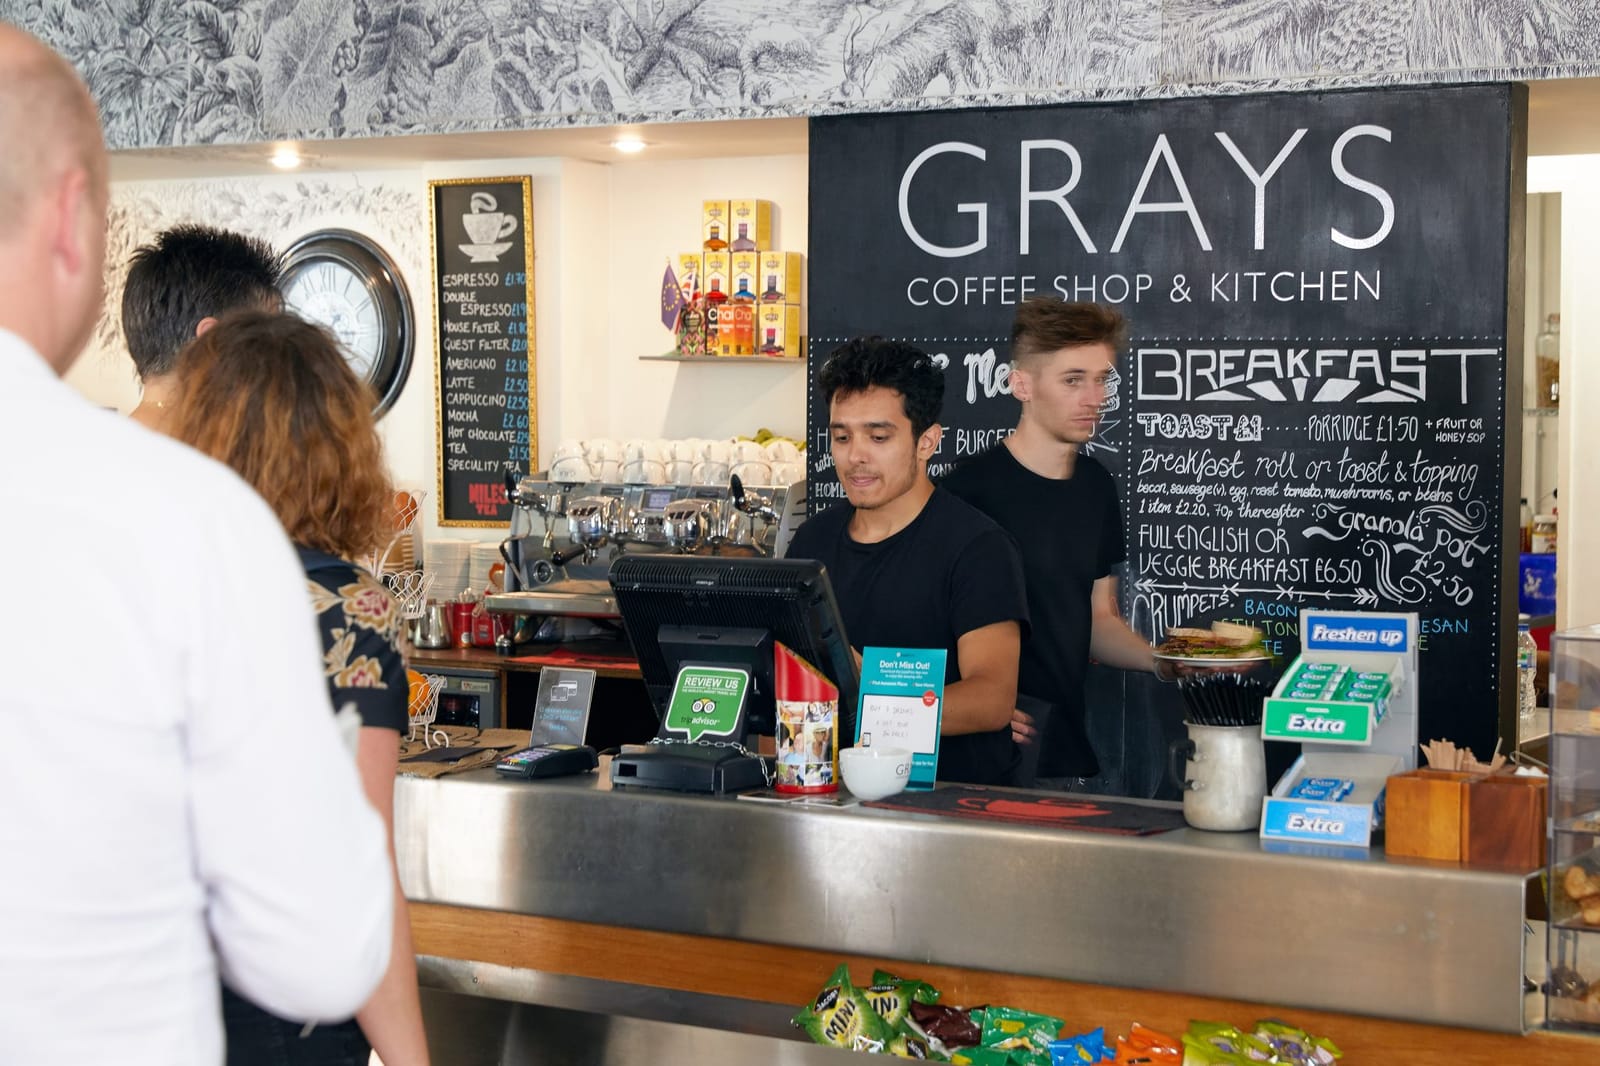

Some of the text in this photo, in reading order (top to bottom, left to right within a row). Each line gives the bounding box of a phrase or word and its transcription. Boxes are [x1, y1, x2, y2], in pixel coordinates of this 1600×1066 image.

[898, 124, 1395, 257] GRAYS
[442, 273, 499, 287] ESPRESSO
[907, 270, 1381, 305] COFFEE SHOP & KITCHEN
[443, 291, 477, 303] DOUBLE
[460, 303, 511, 316] ESPRESSO
[443, 320, 470, 333] HOUSE
[472, 321, 501, 334] FILTER
[443, 338, 475, 350] GUEST
[479, 339, 510, 351] FILTER
[445, 356, 496, 370] AMERICANO
[446, 377, 475, 389] LATTE
[1137, 349, 1498, 405] BREAKFAST
[446, 393, 506, 407] CAPPUCCINO
[448, 410, 479, 422] MOCHA
[448, 426, 465, 438] HOT
[468, 428, 516, 443] CHOCOLATE
[1137, 413, 1233, 441] TOAST
[1308, 414, 1373, 442] PORRIDGE
[1436, 417, 1467, 430] FRUIT
[1469, 417, 1483, 429] OR
[1435, 431, 1467, 444] HONEY
[447, 442, 468, 454] TEA
[448, 458, 521, 473] SPECIALITY TEA
[1137, 446, 1479, 500] Breakfast roll or toast & topping
[469, 482, 508, 503] MILES
[1136, 479, 1169, 496] bacon,
[1250, 482, 1279, 497] roast
[1324, 483, 1394, 502] mushrooms,
[1398, 490, 1412, 501] or
[1414, 486, 1453, 503] beans
[475, 503, 498, 516] TEA
[1148, 497, 1172, 513] item
[1213, 503, 1234, 521] 70p
[1237, 502, 1305, 526] thereafter
[1336, 508, 1424, 542] granola
[1138, 524, 1290, 555] FULL ENGLISH OR
[1427, 528, 1491, 568] pot
[1139, 552, 1362, 584] VEGGIE BREAKFAST £6.50
[1245, 599, 1298, 618] BACON
[1312, 624, 1378, 643] Freshen
[1379, 628, 1403, 647] up
[880, 660, 931, 670] Don't Miss Out!
[684, 677, 739, 689] REVIEW US
[1287, 713, 1346, 734] Extra
[1286, 812, 1345, 834] Extra
[872, 996, 898, 1016] INI
[825, 999, 856, 1041] MINI
